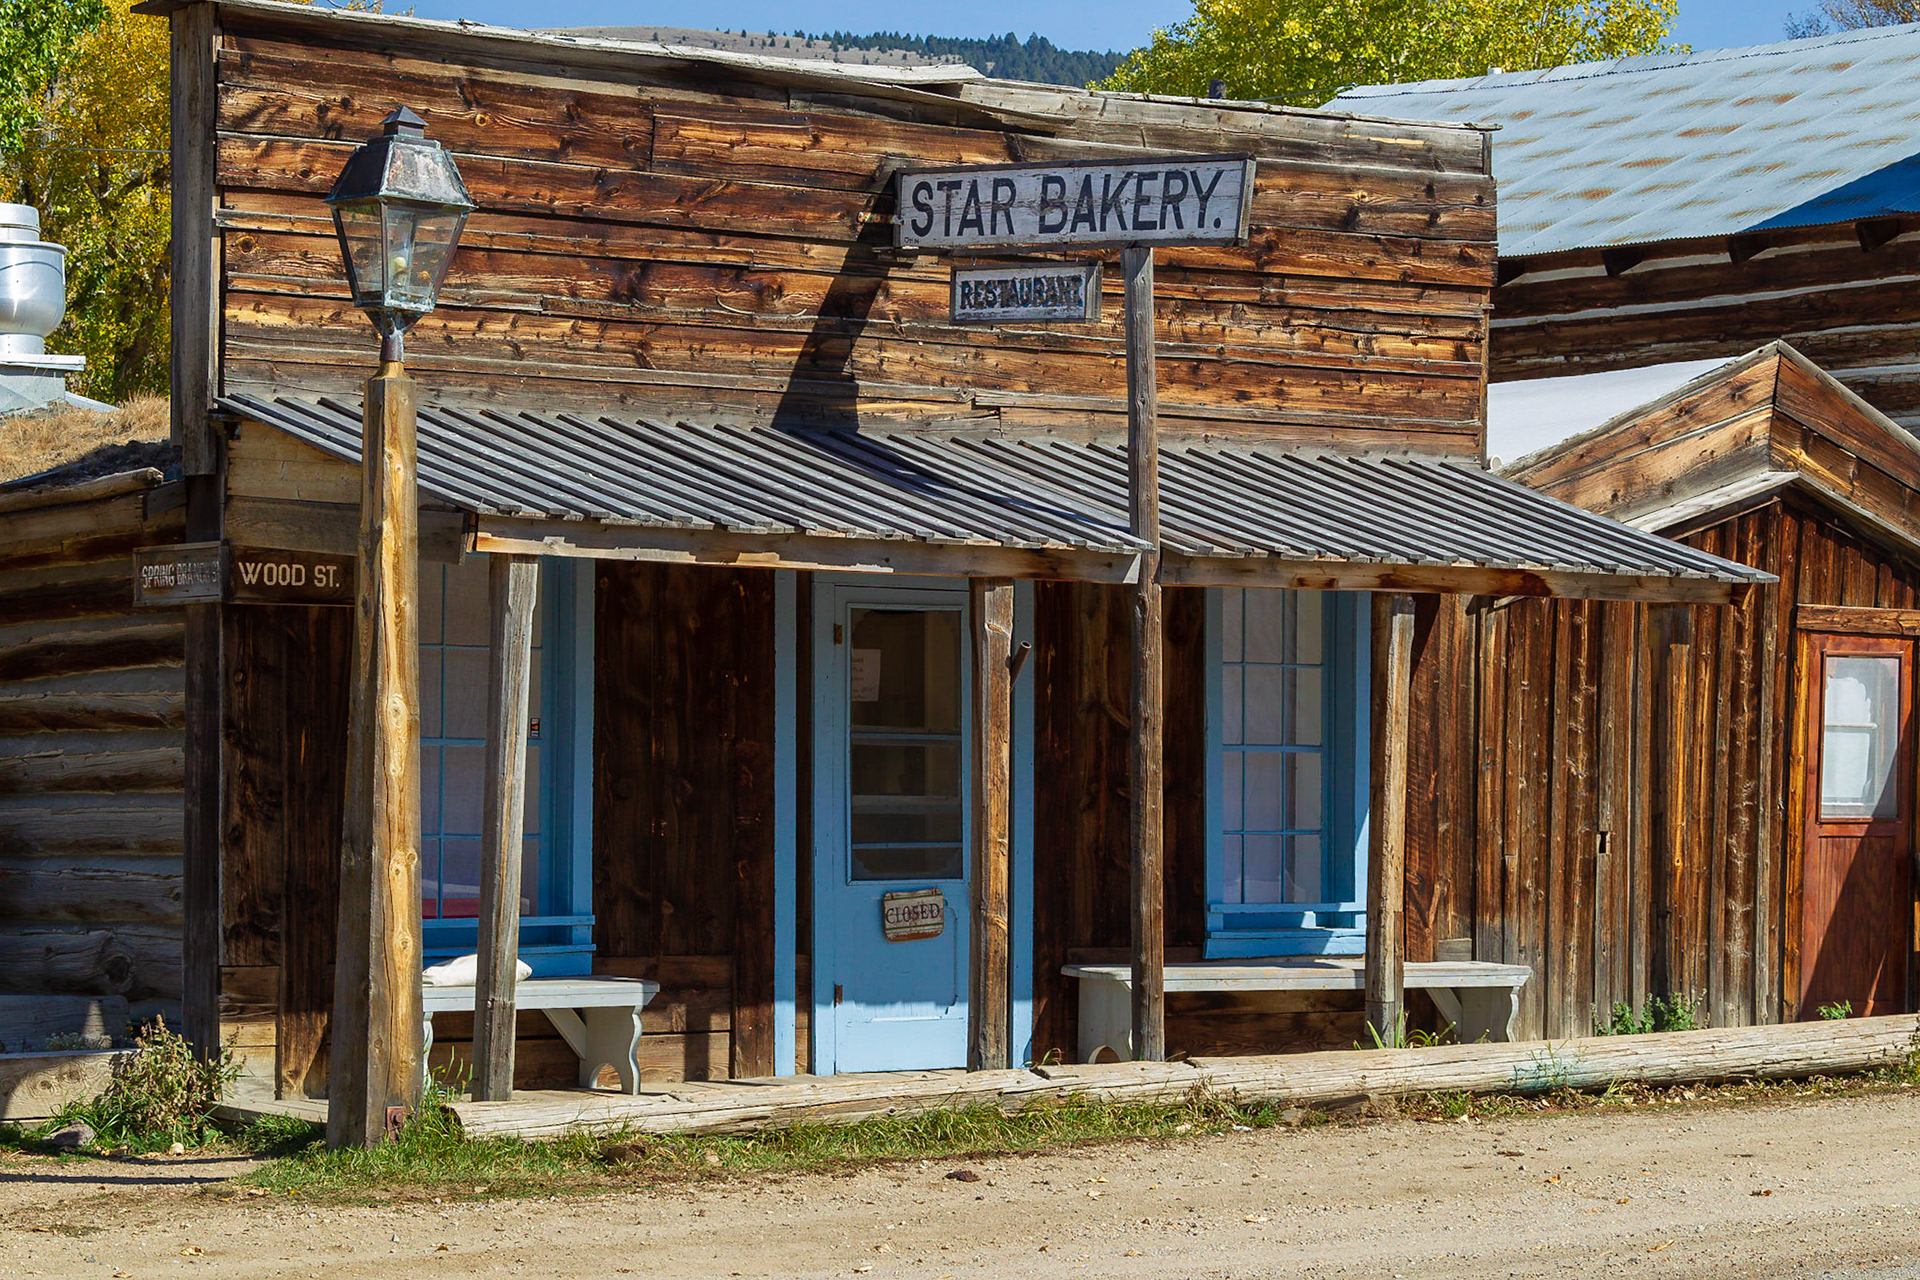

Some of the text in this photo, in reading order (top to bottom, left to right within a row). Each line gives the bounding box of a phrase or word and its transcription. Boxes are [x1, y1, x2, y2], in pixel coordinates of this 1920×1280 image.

[911, 169, 1225, 238] STAR BAKERY.
[959, 275, 1084, 310] RESTAURANT
[141, 563, 175, 589] SPRING
[238, 562, 341, 588] WOOD ST.
[885, 903, 941, 924] CLOSED
